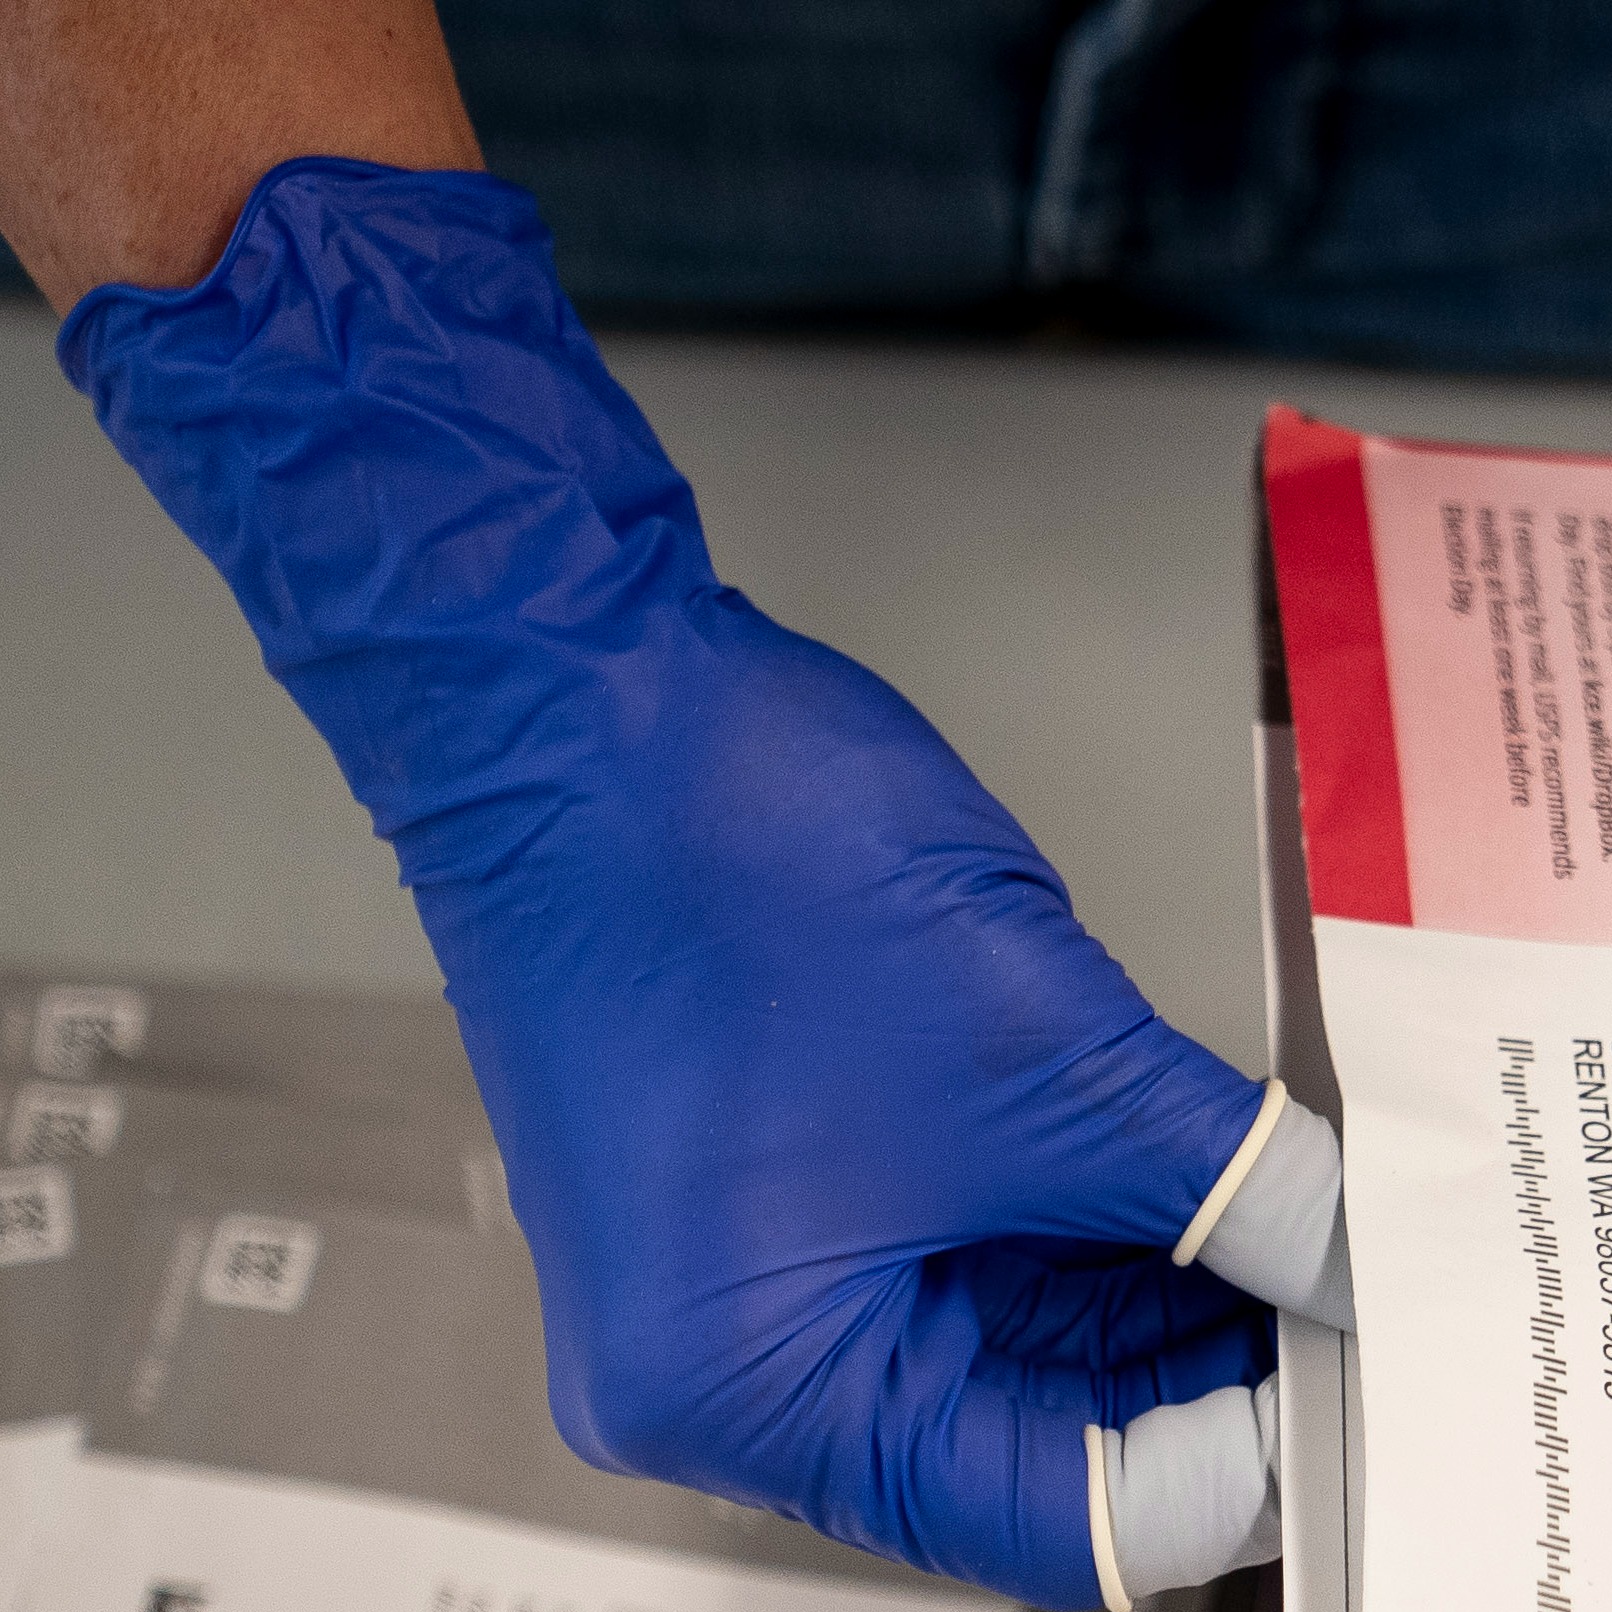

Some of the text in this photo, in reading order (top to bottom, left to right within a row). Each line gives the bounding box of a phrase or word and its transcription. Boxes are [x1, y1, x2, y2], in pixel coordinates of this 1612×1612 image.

[1499, 683, 1527, 737] week
[1504, 740, 1533, 808] before
[1541, 745, 1578, 881] recommends
[1573, 1038, 1612, 1164] RENTON
